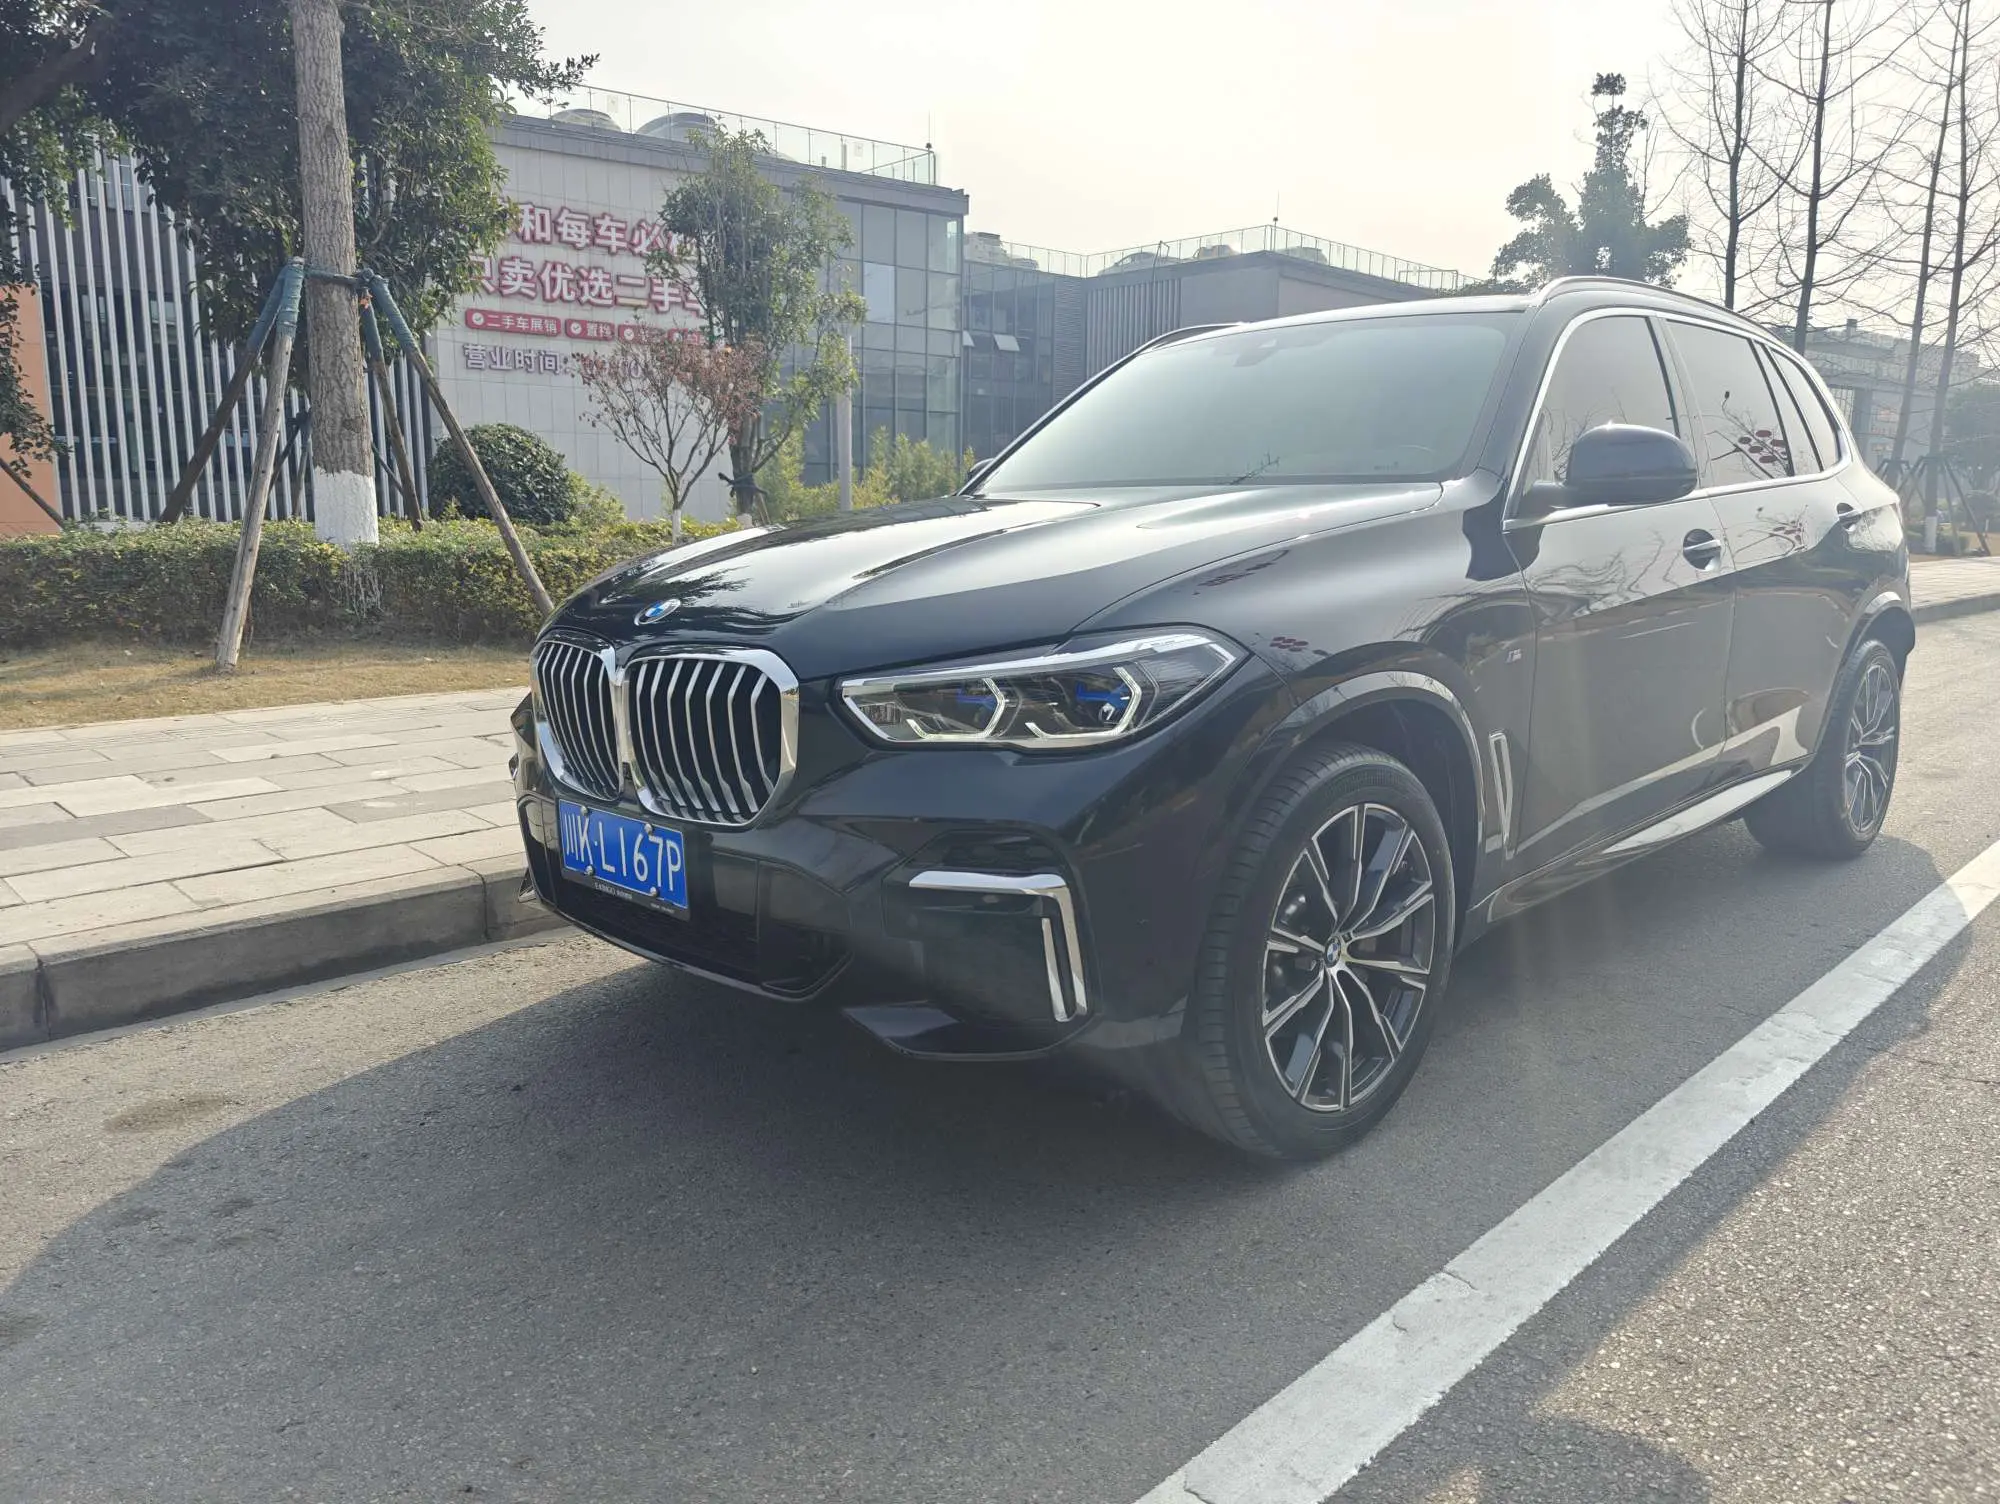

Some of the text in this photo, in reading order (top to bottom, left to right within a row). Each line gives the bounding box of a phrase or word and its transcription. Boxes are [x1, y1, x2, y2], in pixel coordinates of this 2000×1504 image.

[487, 313, 558, 334] 二手车展销
[463, 343, 560, 375] 营业时间
